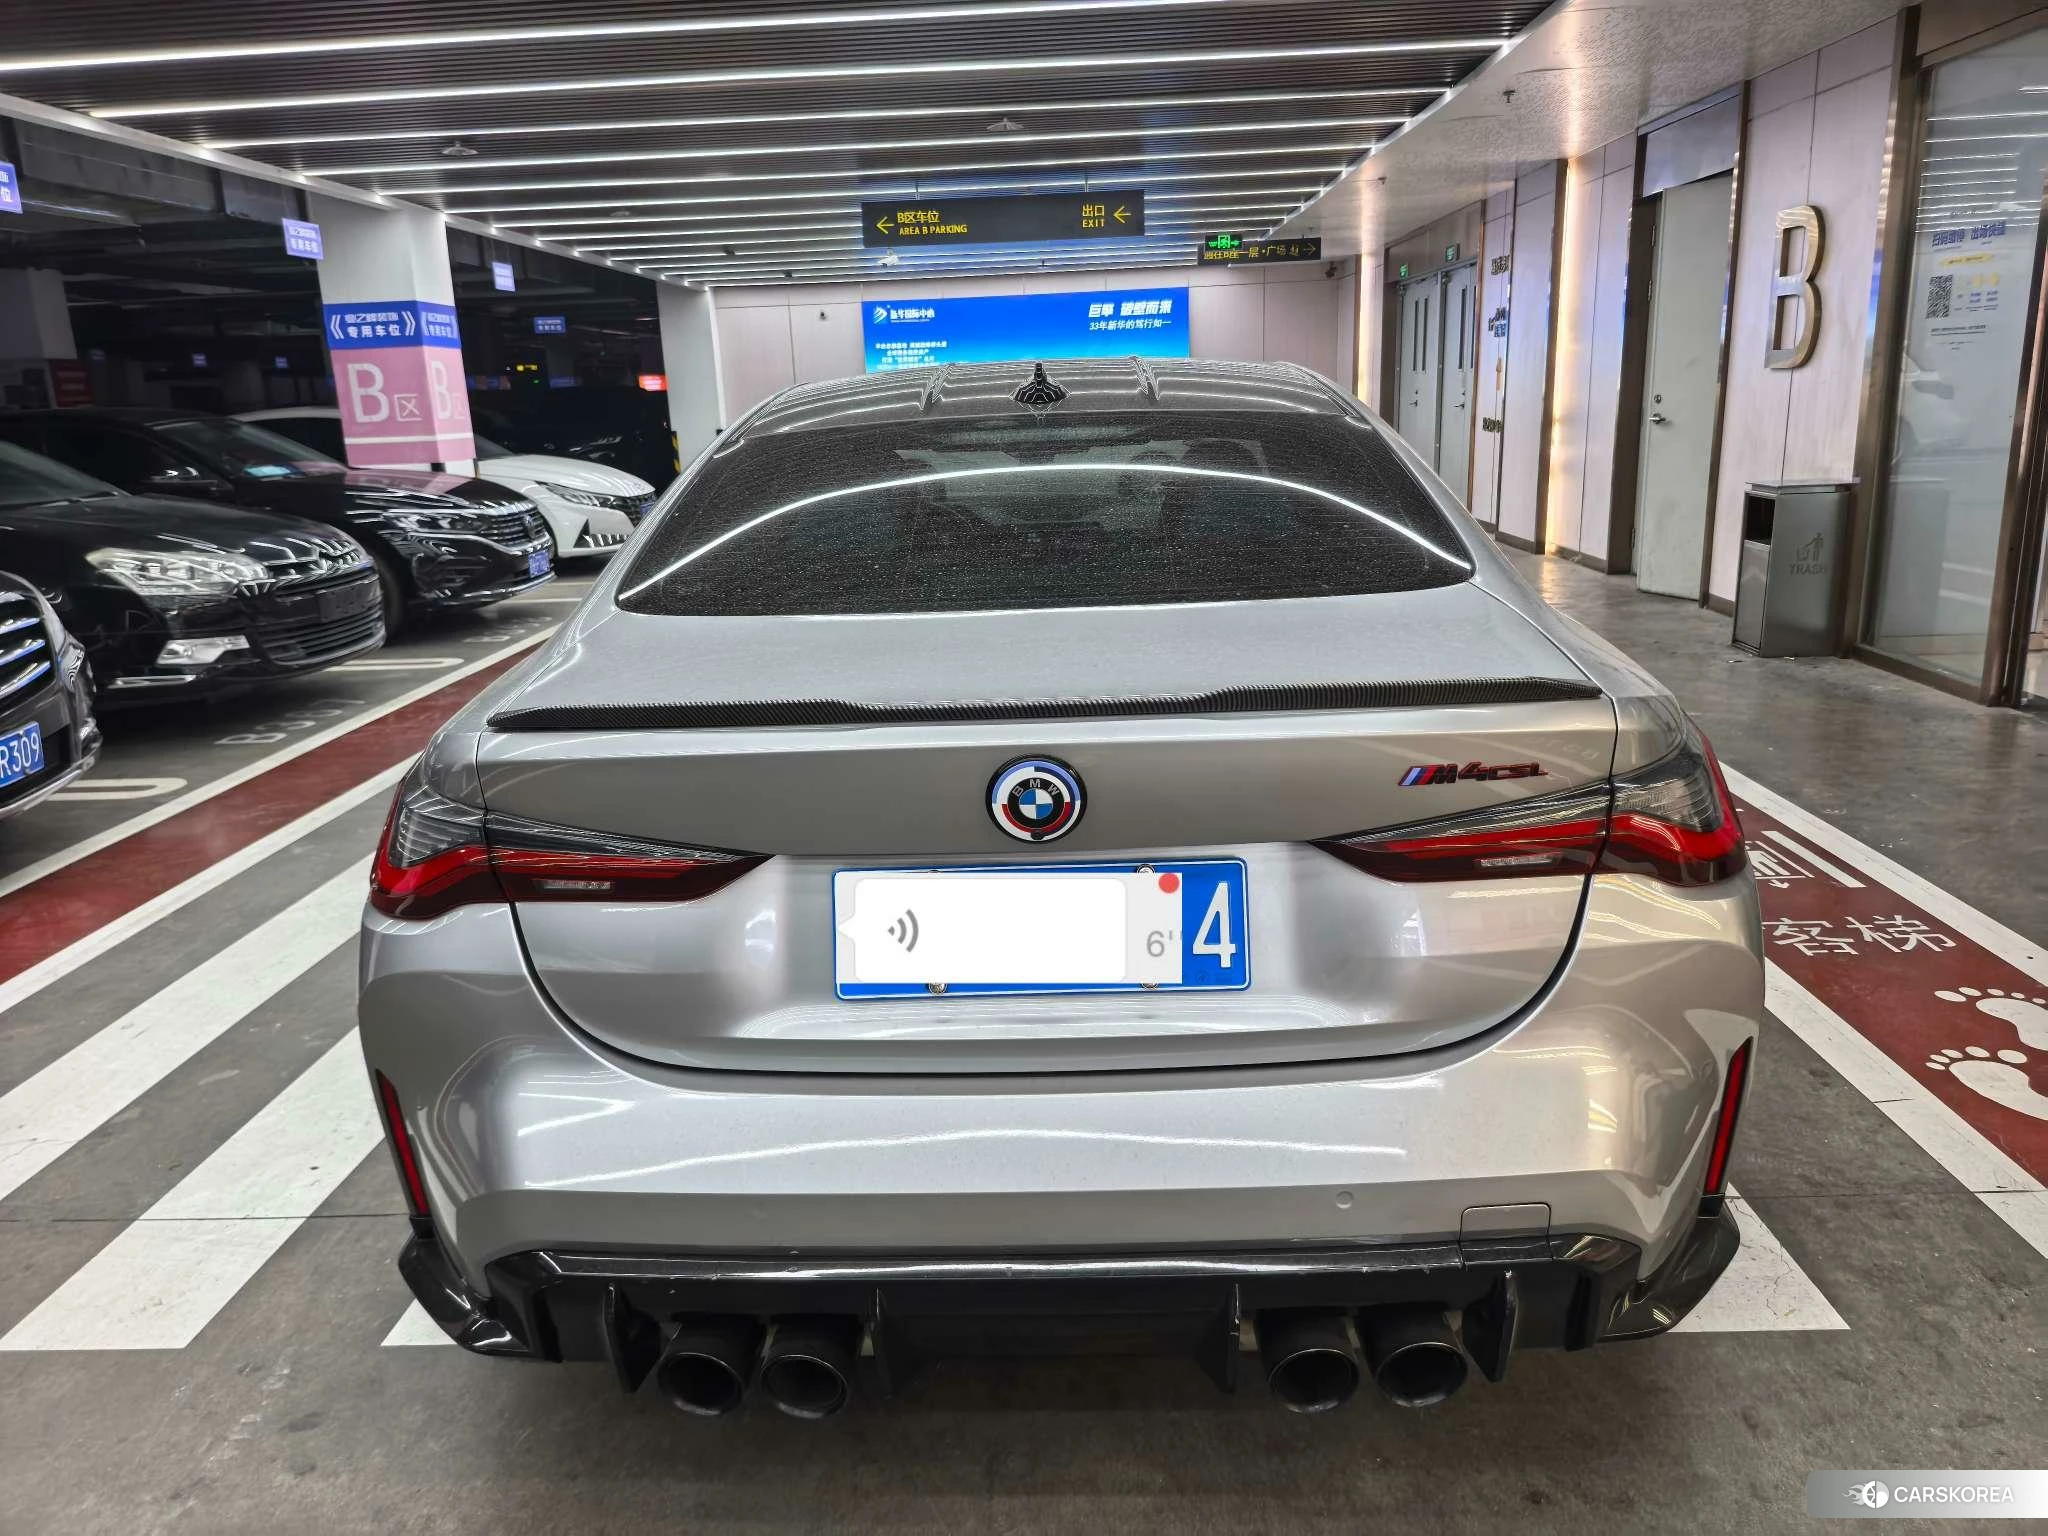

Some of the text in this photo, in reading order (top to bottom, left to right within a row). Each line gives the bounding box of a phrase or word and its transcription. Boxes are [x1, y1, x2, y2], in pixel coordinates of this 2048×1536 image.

[897, 210, 941, 224] B区车位
[1082, 204, 1105, 218] 出口
[899, 224, 968, 236] AREA B PARKING
[1082, 219, 1105, 229] EXIT
[1764, 205, 1826, 369] B
[0, 732, 40, 779] R309
[1011, 778, 1060, 798] BMW
[1192, 880, 1237, 969] 4
[1761, 914, 1958, 957] 客梯
